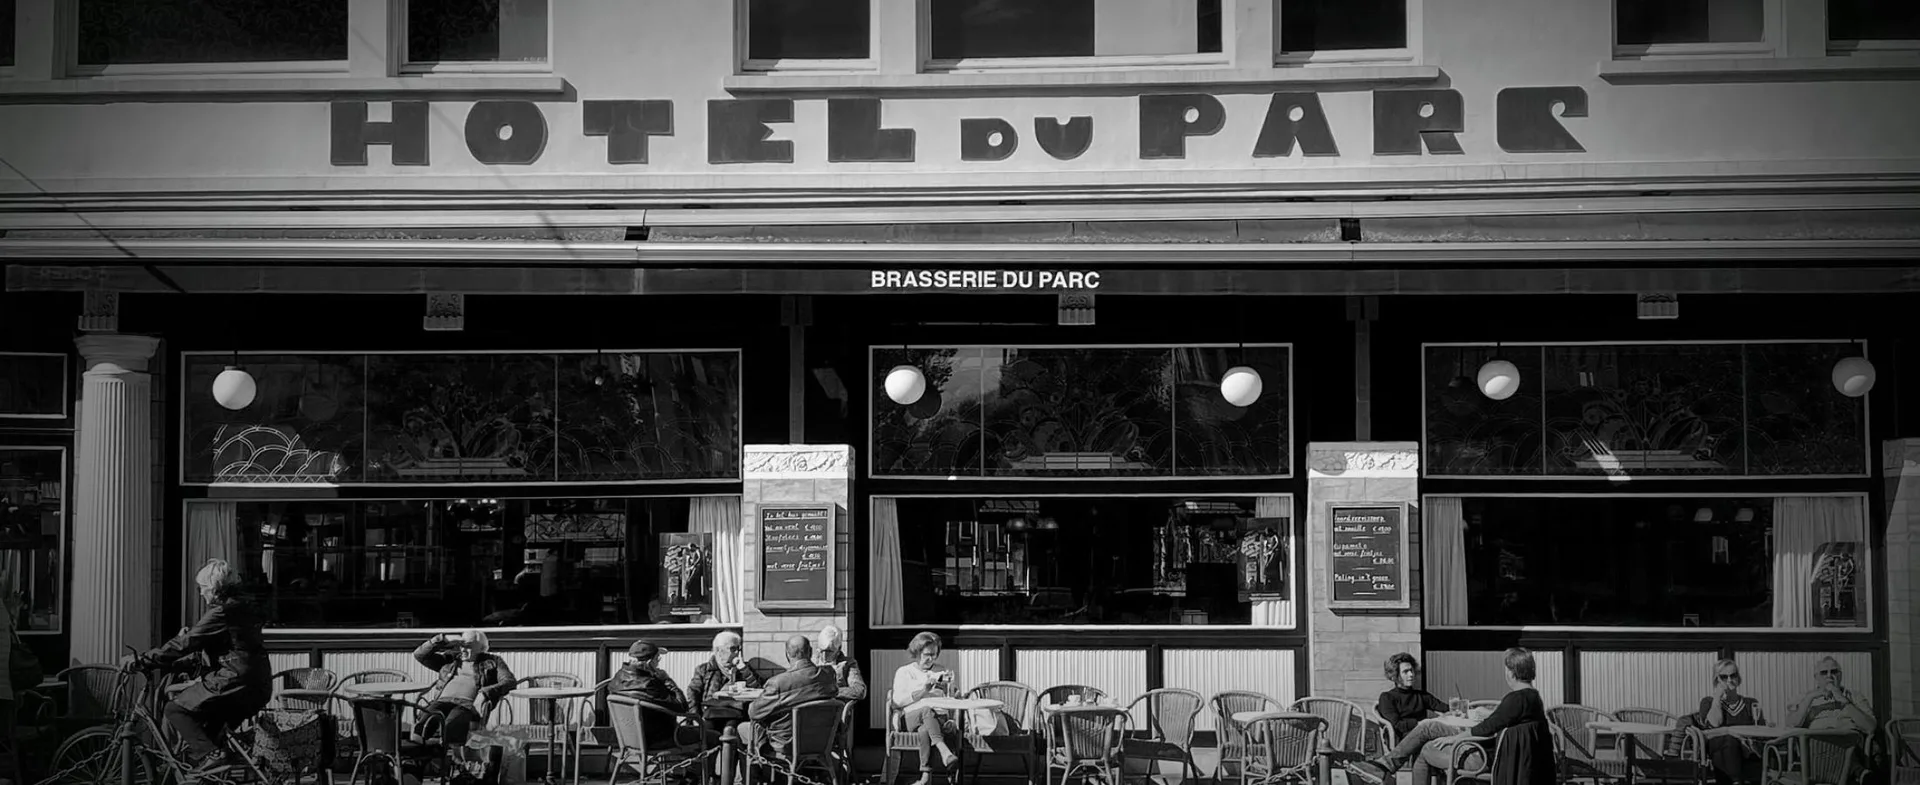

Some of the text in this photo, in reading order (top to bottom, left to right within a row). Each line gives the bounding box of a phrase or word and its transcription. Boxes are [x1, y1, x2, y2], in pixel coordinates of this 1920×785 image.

[330, 86, 1589, 166] HOTEL DU PARC
[871, 270, 1100, 289] BRASSERIE DU PARC
[1334, 574, 1355, 583] Paling
